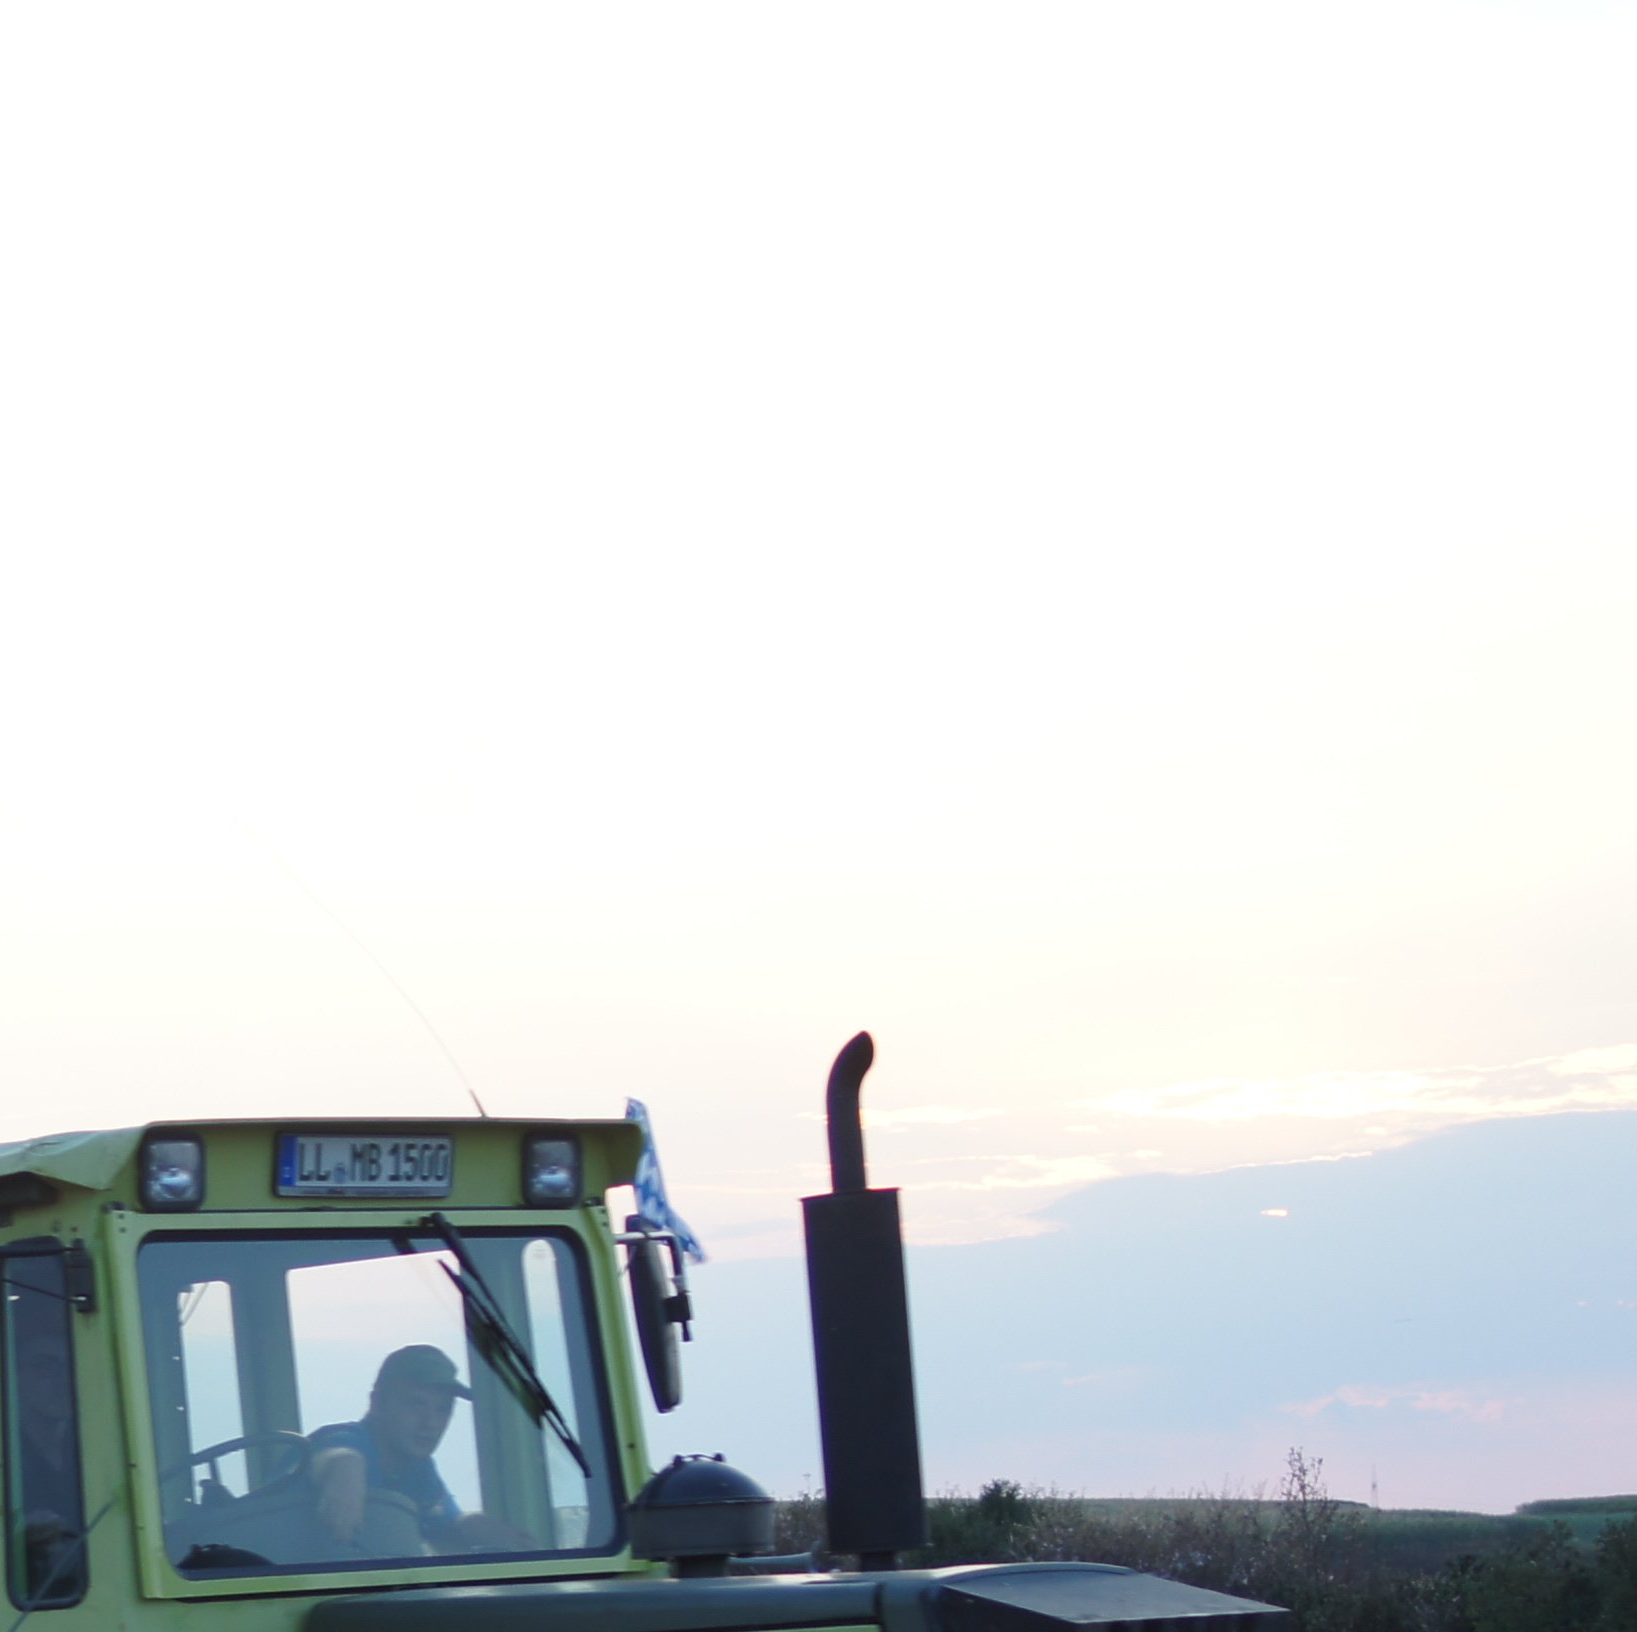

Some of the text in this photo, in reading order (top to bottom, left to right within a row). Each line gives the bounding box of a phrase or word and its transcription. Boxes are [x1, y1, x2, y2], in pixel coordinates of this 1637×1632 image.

[298, 1143, 451, 1182] LL MB 1500
